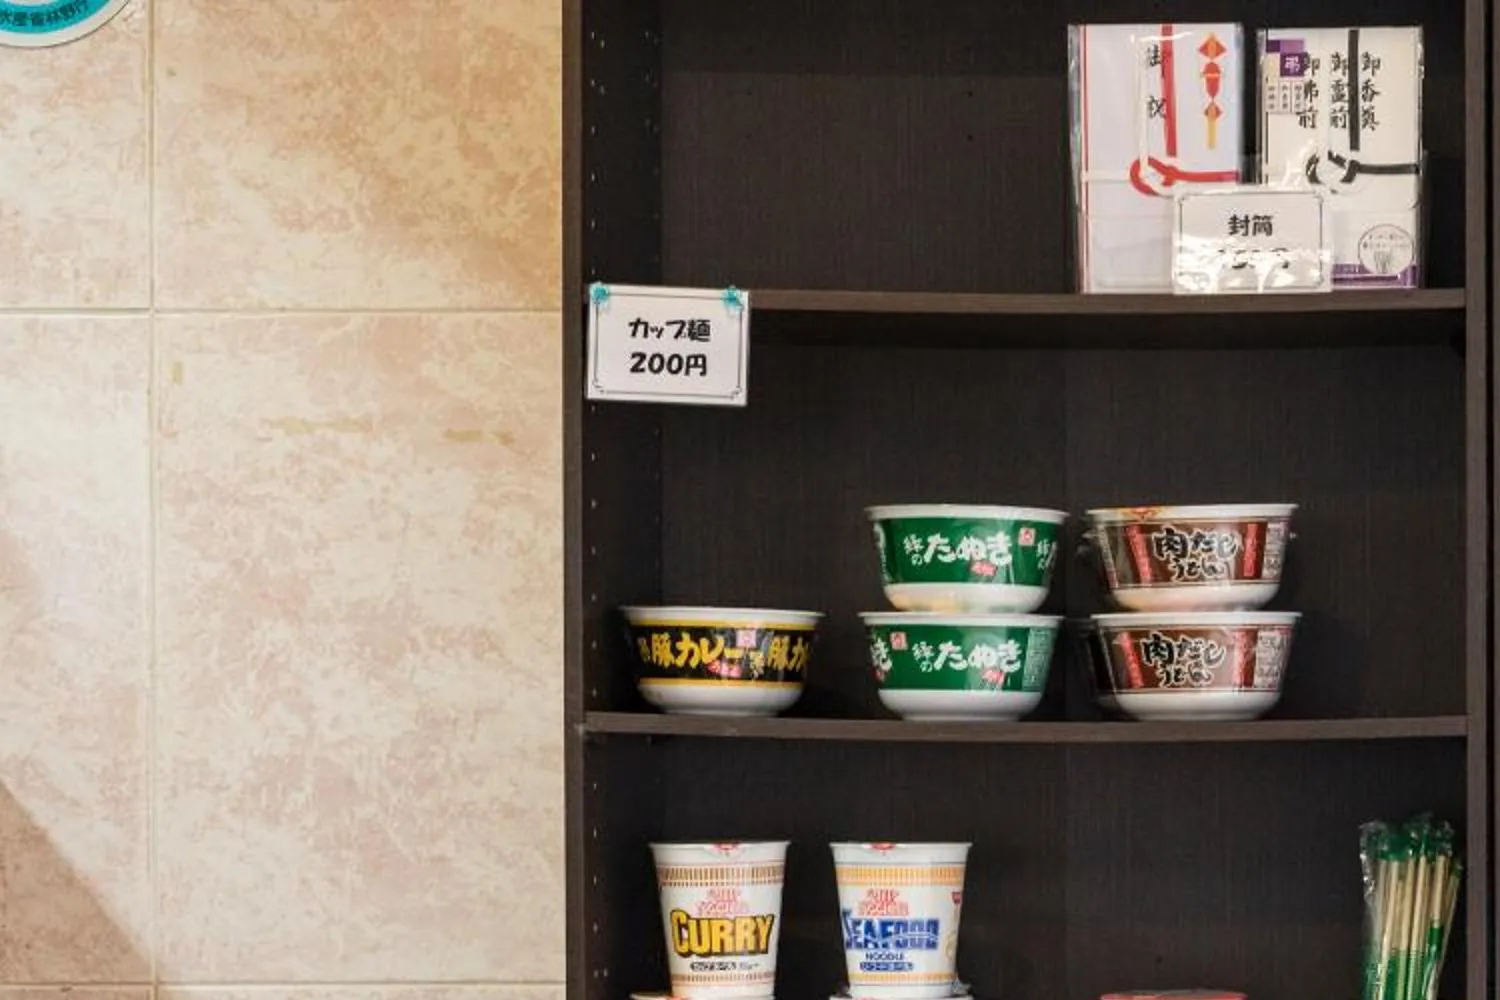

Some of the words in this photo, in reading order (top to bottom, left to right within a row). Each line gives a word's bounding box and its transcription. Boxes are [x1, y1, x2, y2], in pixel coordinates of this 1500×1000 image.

[1228, 214, 1274, 237] 封筒
[628, 316, 711, 343] カップ麺
[629, 351, 707, 377] 200円
[670, 908, 775, 958] CURRY
